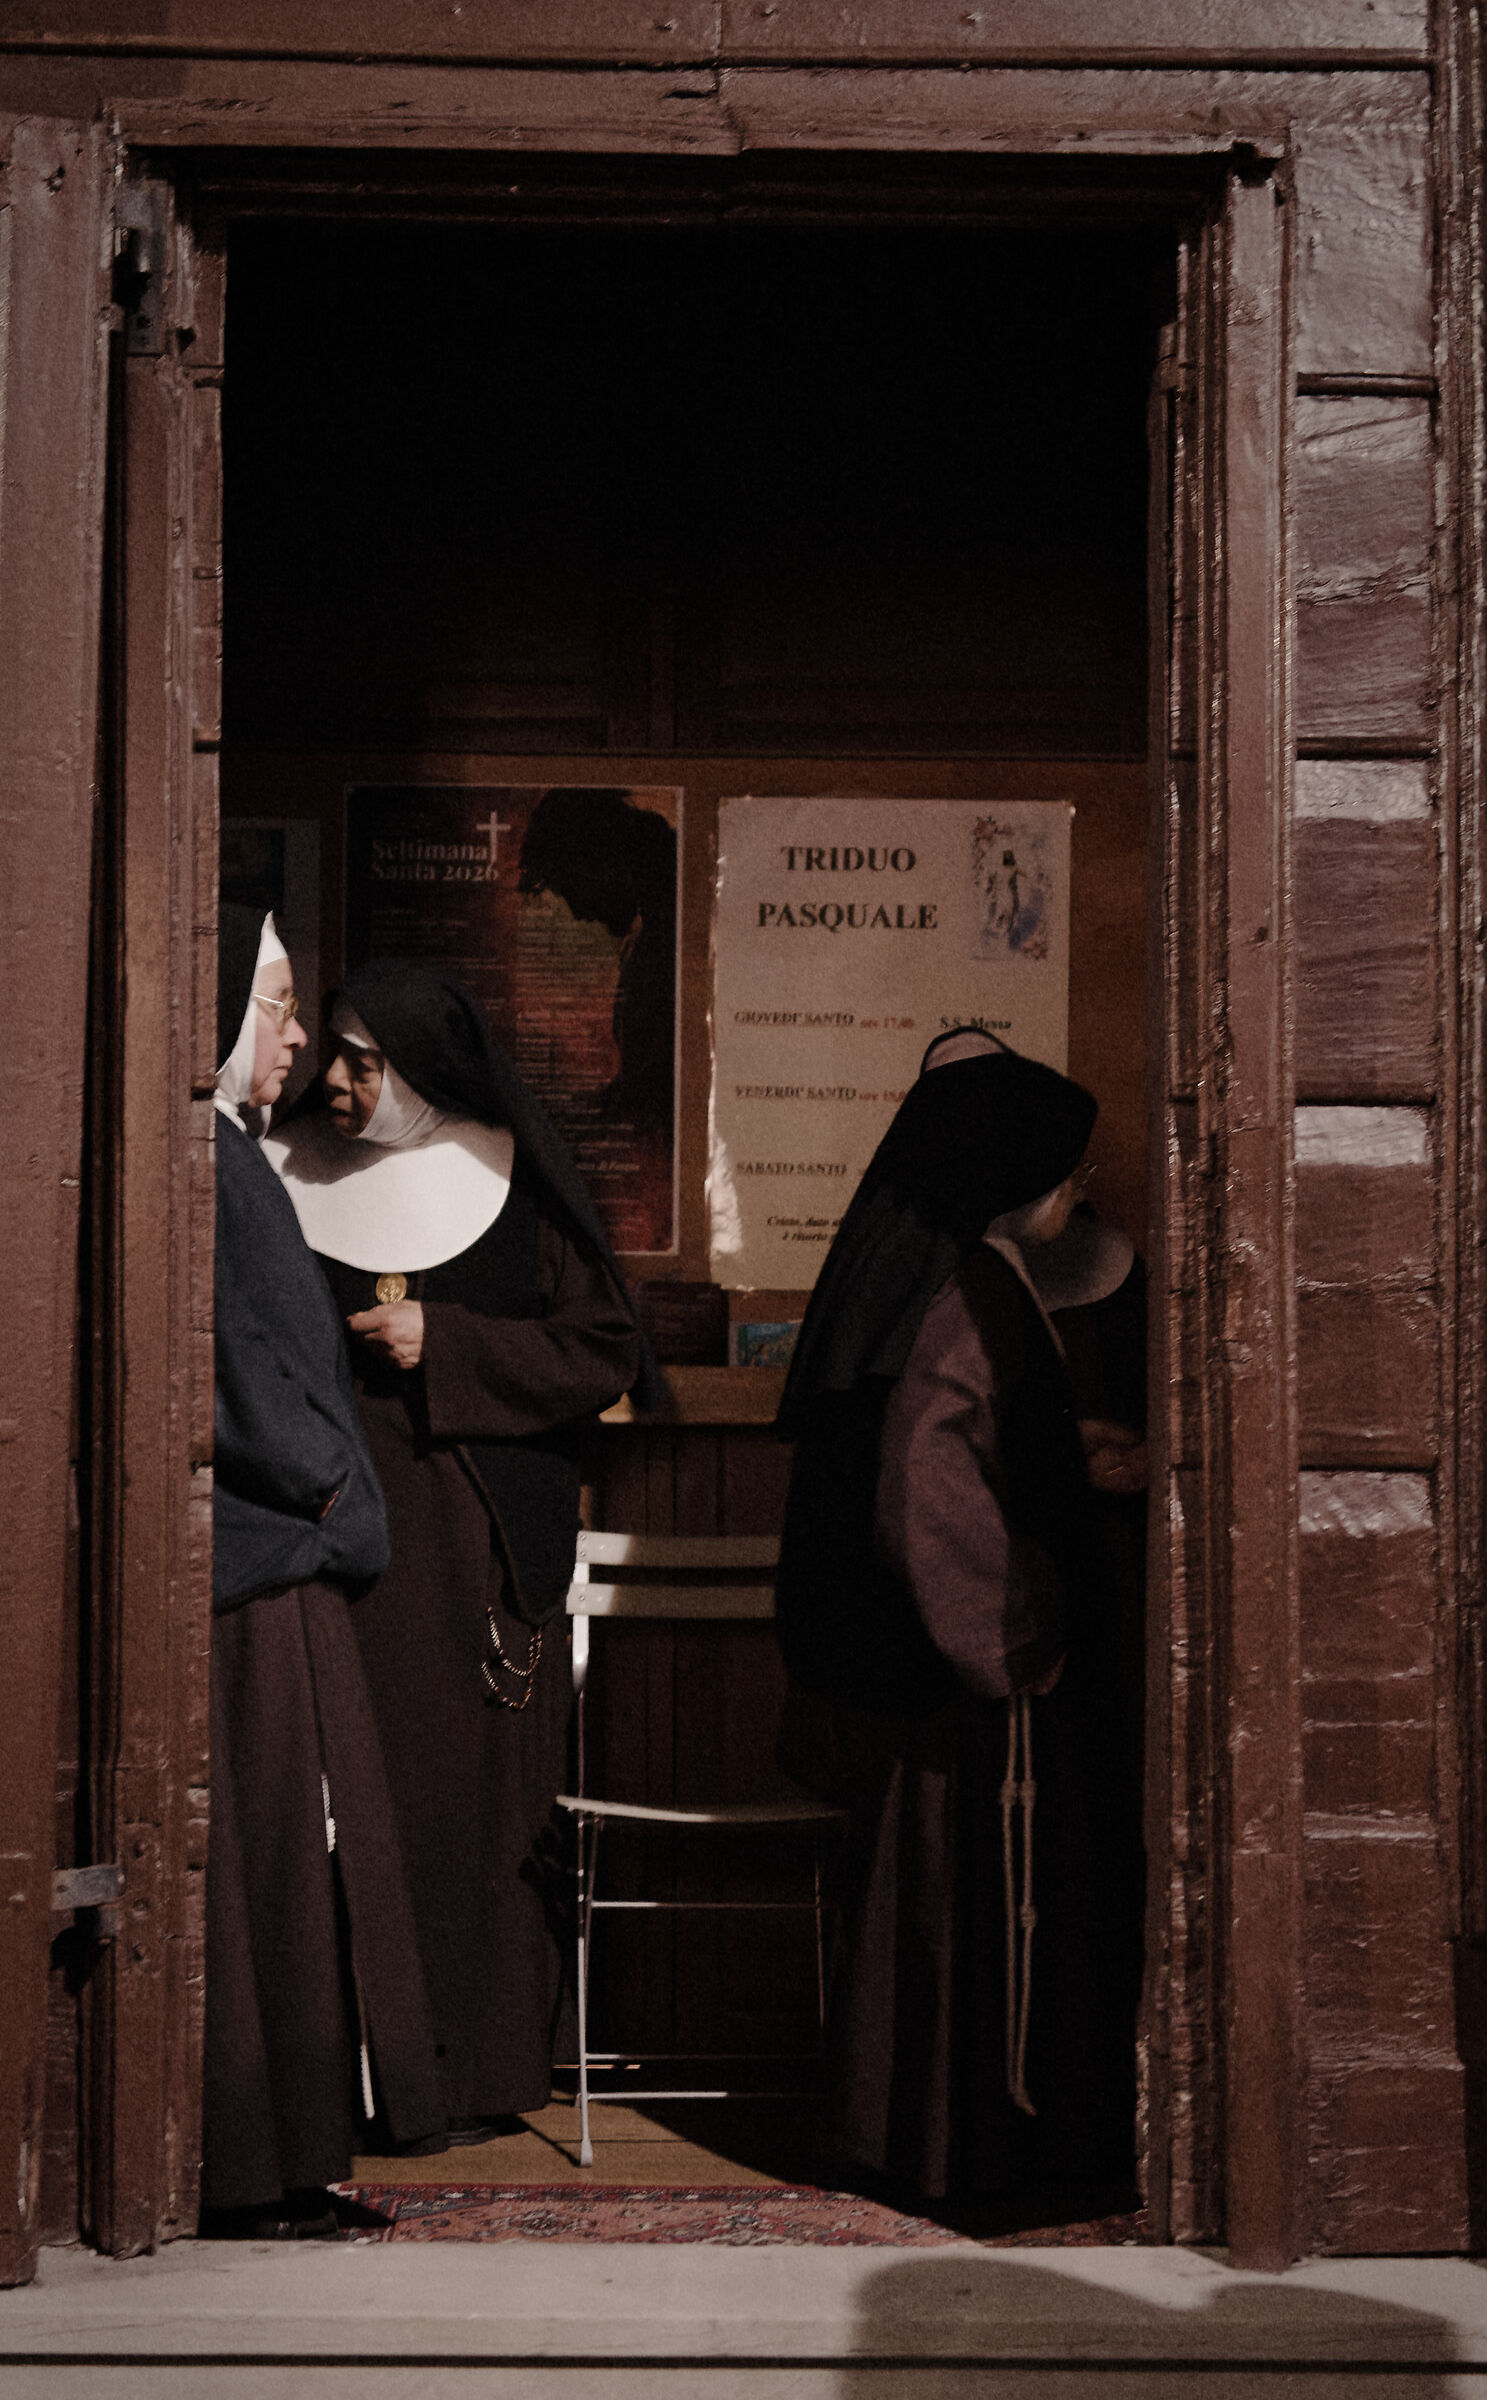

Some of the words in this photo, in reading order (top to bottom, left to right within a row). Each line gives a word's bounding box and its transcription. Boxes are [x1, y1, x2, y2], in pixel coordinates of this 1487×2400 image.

[780, 846, 917, 872] TRIDUO
[757, 902, 938, 932] PASQUALE
[804, 1012, 855, 1026] SANTO
[807, 1086, 857, 1100] SANTO
[736, 1161, 794, 1175] SABATO
[796, 1162, 847, 1176] SANTO
